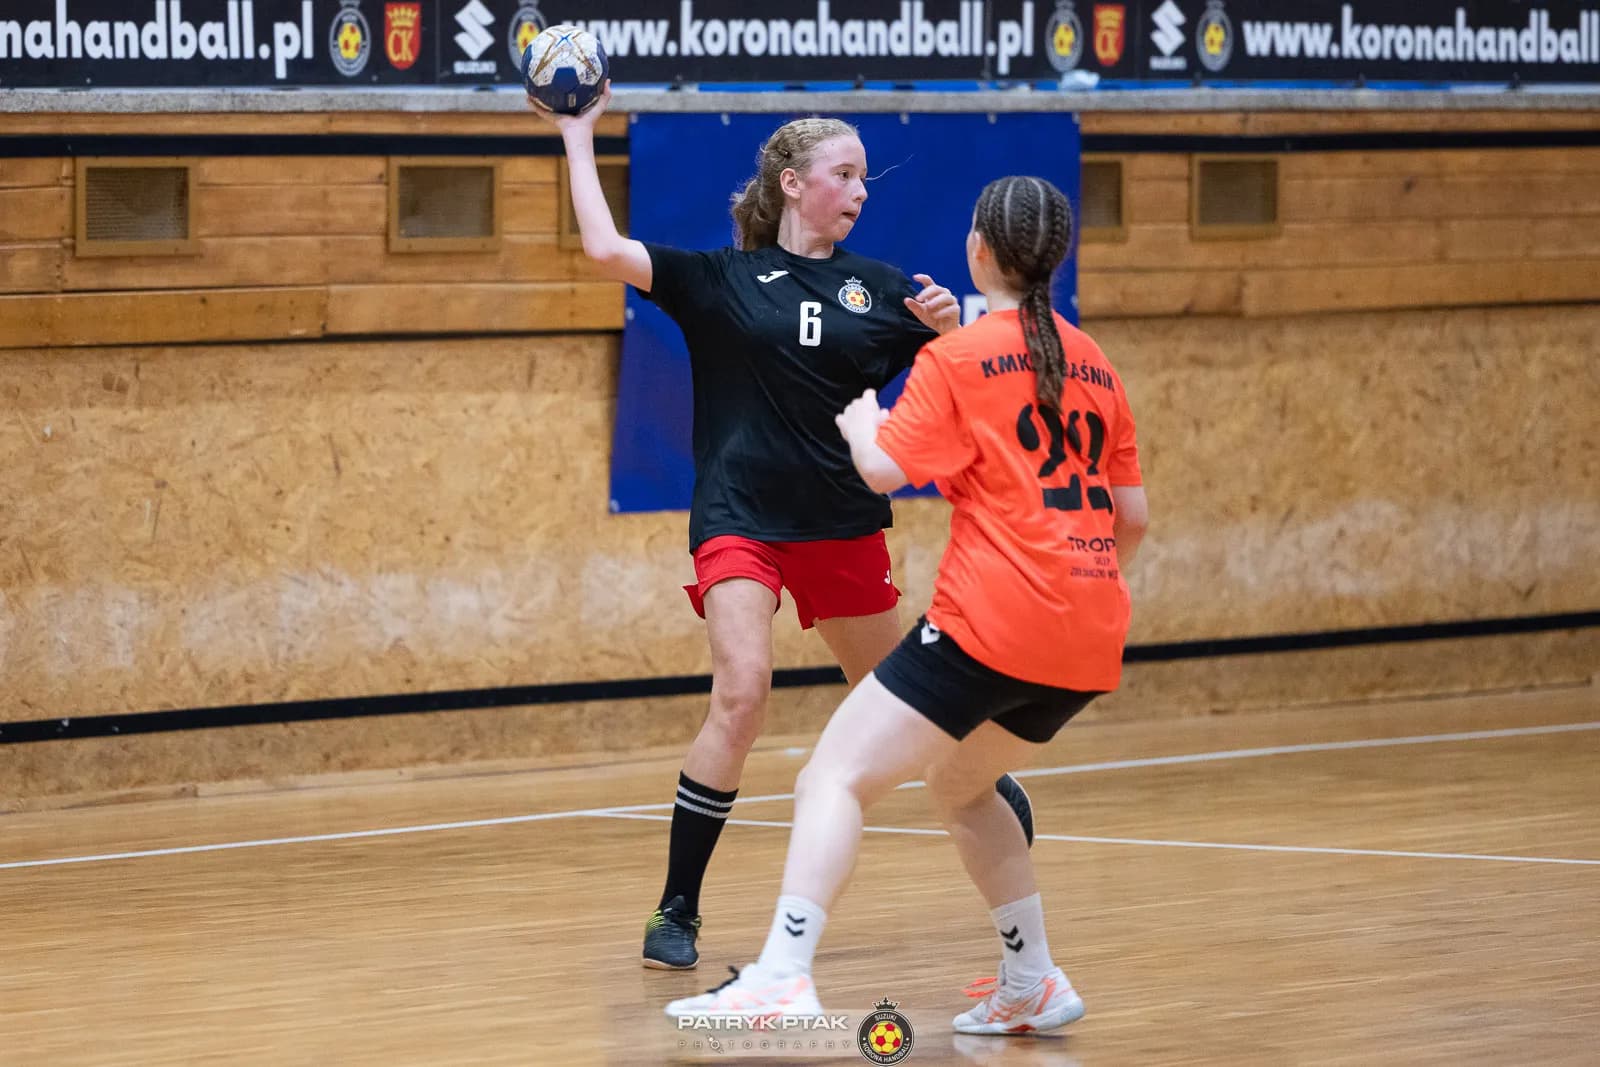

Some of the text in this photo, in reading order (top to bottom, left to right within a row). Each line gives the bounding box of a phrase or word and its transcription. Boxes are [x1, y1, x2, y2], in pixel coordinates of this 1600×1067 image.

[799, 301, 822, 347] 6
[981, 353, 1034, 378] KMK
[1016, 403, 1114, 515] 22
